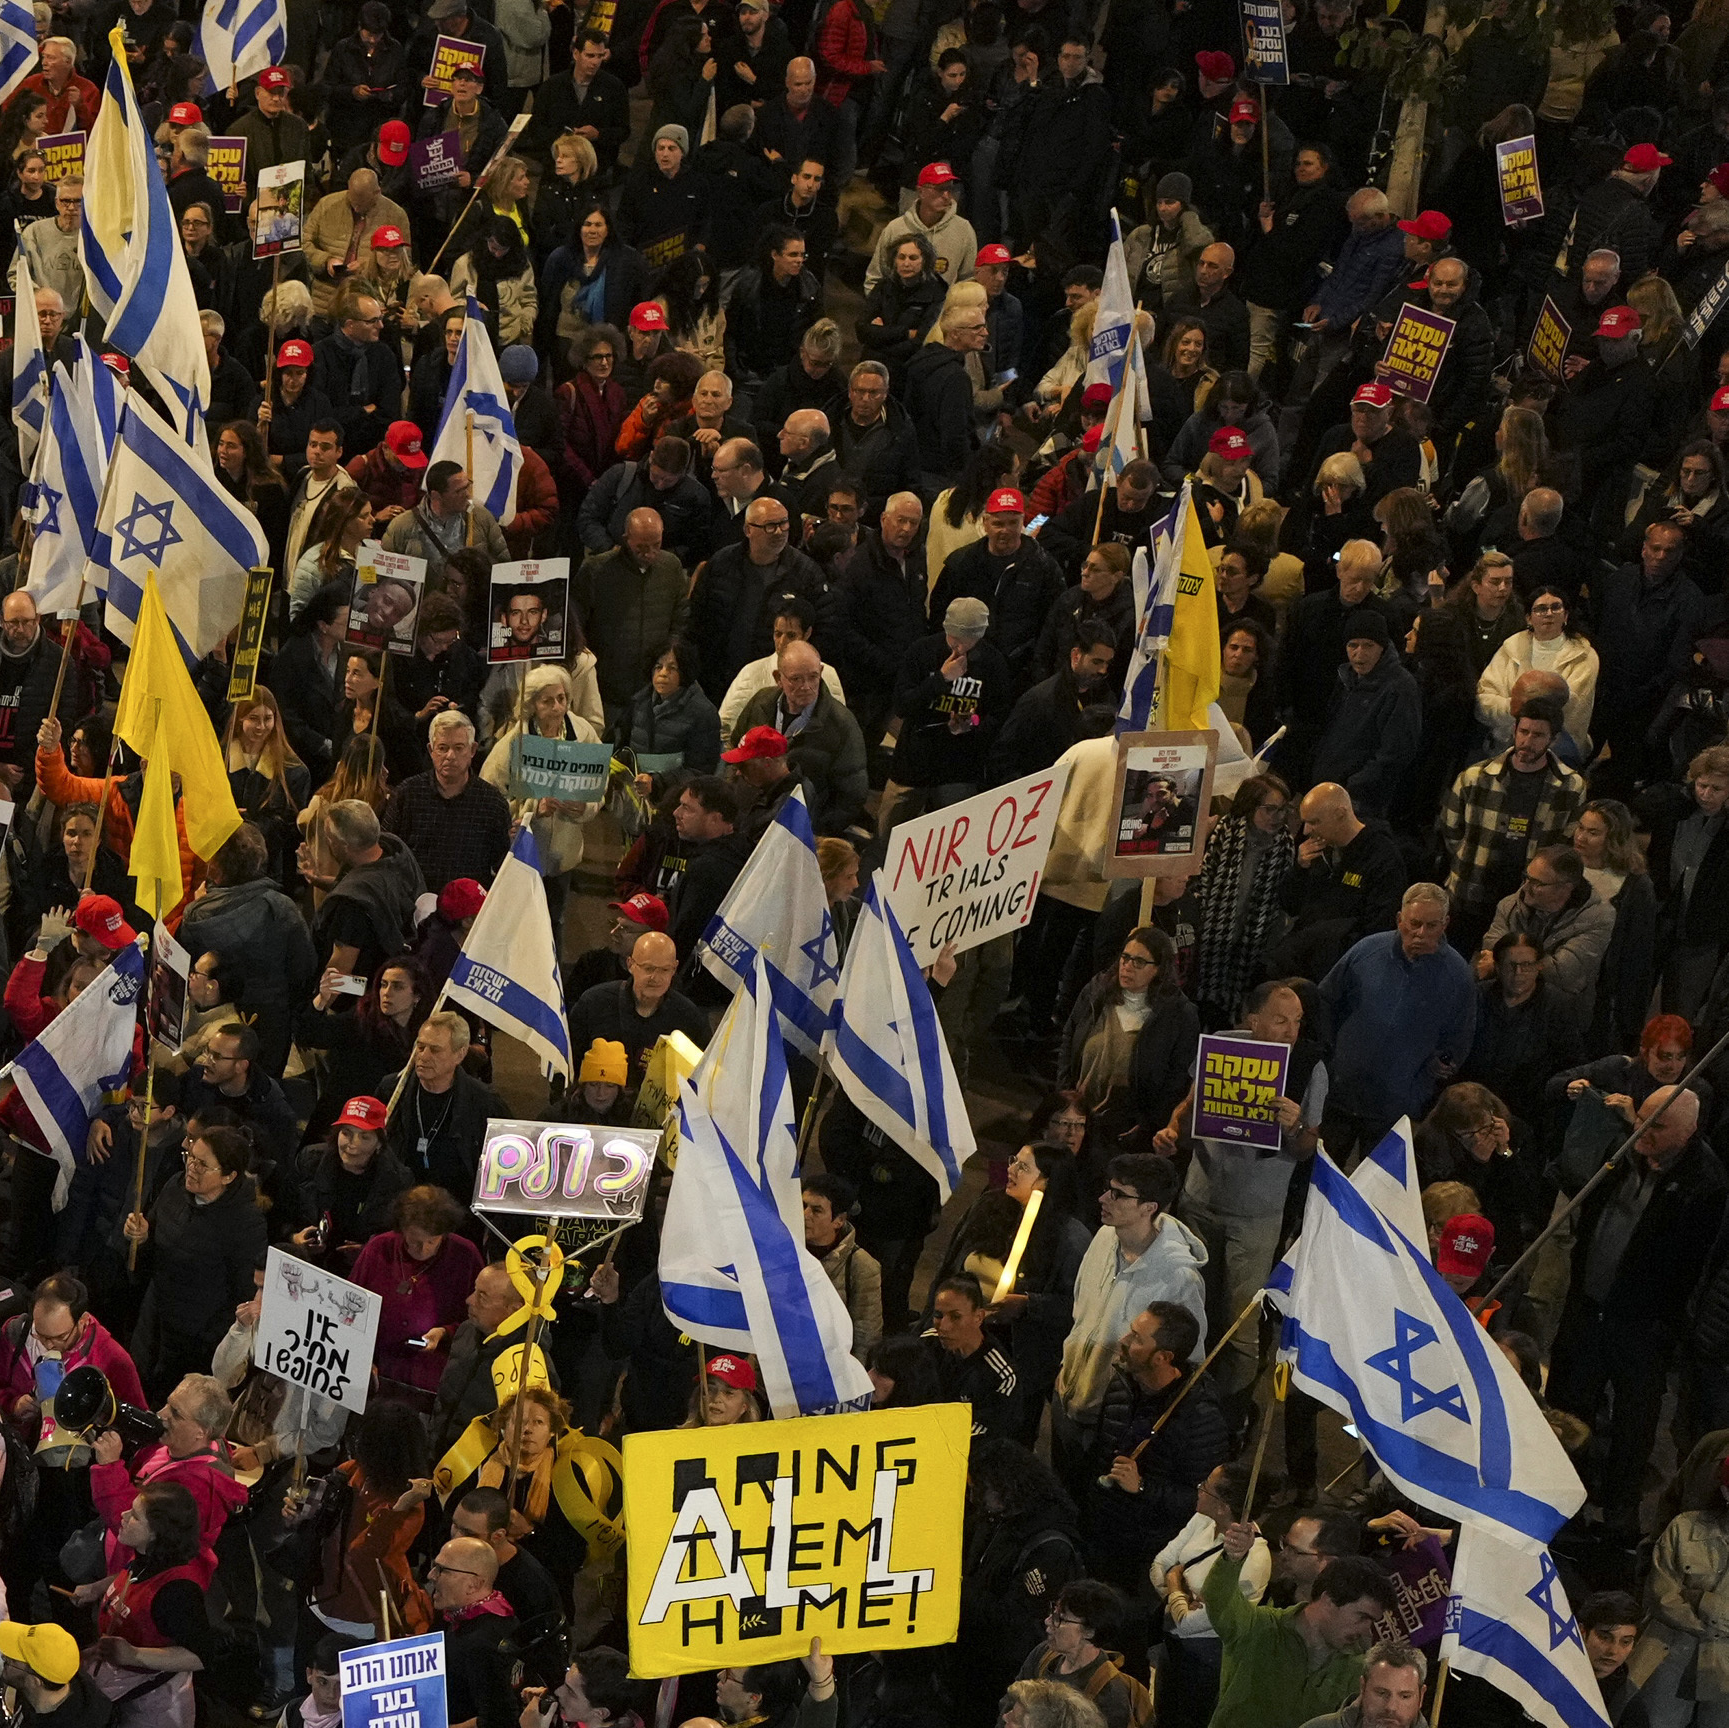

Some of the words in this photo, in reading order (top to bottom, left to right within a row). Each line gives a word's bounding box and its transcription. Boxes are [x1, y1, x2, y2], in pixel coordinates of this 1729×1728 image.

[1391, 336, 1440, 364] מלאה
[1399, 317, 1447, 347] עסקה
[892, 815, 971, 893] NIR
[986, 779, 1054, 858] OZ
[926, 855, 1008, 907] TRIALS
[929, 871, 1039, 950] COMING!
[1205, 1052, 1280, 1080] עסקה
[1206, 1077, 1277, 1108] מלאה
[480, 1127, 651, 1199] כולם
[304, 1308, 340, 1345] אין
[638, 1466, 936, 1626] ALL
[673, 1517, 881, 1576] THEM
[346, 1657, 386, 1690] הרוב
[388, 1647, 439, 1684] אנחנו
[370, 1684, 416, 1715] בעד
